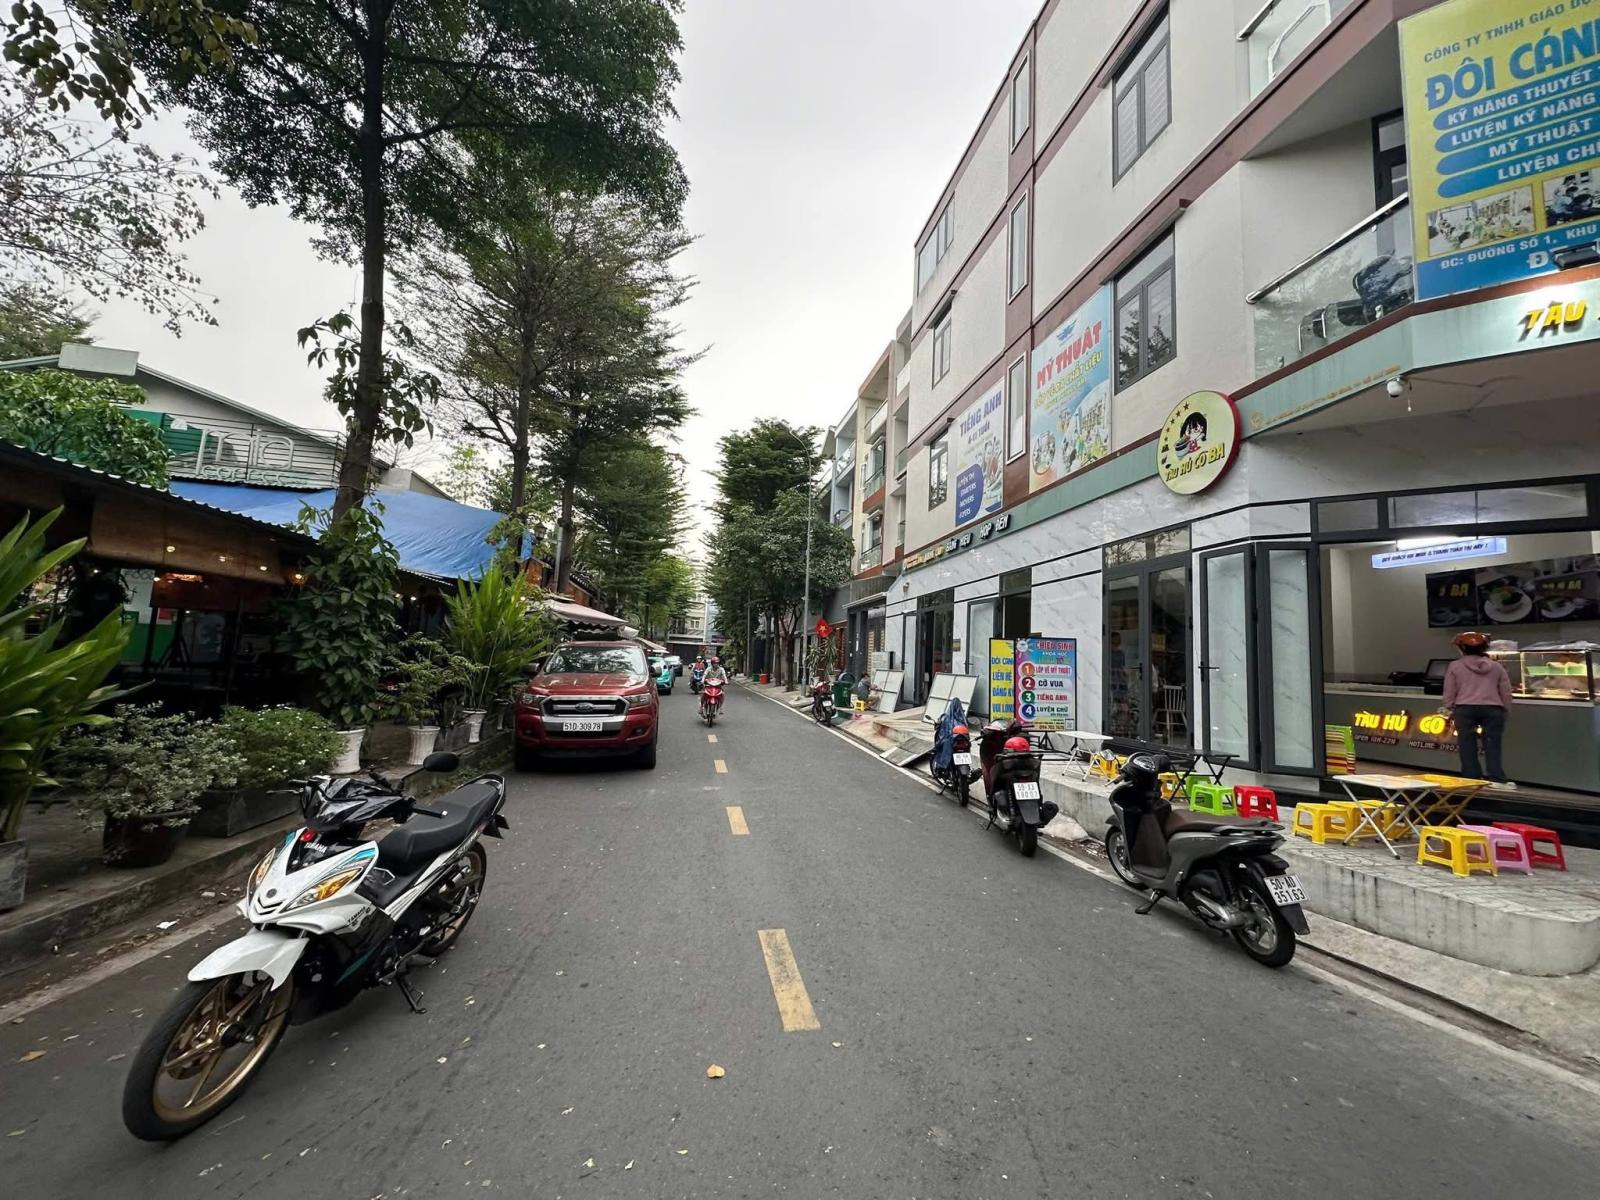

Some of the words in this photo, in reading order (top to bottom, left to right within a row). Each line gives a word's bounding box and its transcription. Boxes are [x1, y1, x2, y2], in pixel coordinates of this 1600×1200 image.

[1465, 33, 1482, 49] TY
[1485, 18, 1525, 41] TNHH
[1425, 57, 1496, 110] ĐÔI
[1508, 18, 1600, 80] CÁN
[1448, 107, 1468, 126] KỸ
[1523, 67, 1593, 100] THUYẾT
[1451, 121, 1508, 147] LUYỆN
[1514, 108, 1537, 128] KỸ
[1542, 91, 1596, 118] NĂNG
[1489, 137, 1520, 158] MỸ
[1525, 117, 1593, 146] THUẬT
[1497, 151, 1560, 180] LUYỆN
[1566, 225, 1597, 240] KHU
[1056, 320, 1102, 374] THUẬT
[960, 408, 982, 437] TIẾNG
[984, 390, 1002, 418] ANH
[1025, 678, 1032, 688] 2
[1038, 678, 1048, 688] CỜ
[1050, 680, 1064, 688] VUA
[1025, 692, 1032, 702] 3
[1025, 705, 1033, 715] 4
[1354, 710, 1381, 729] TÀU
[1383, 710, 1408, 732] HỦ
[1269, 876, 1297, 890] 50-AD
